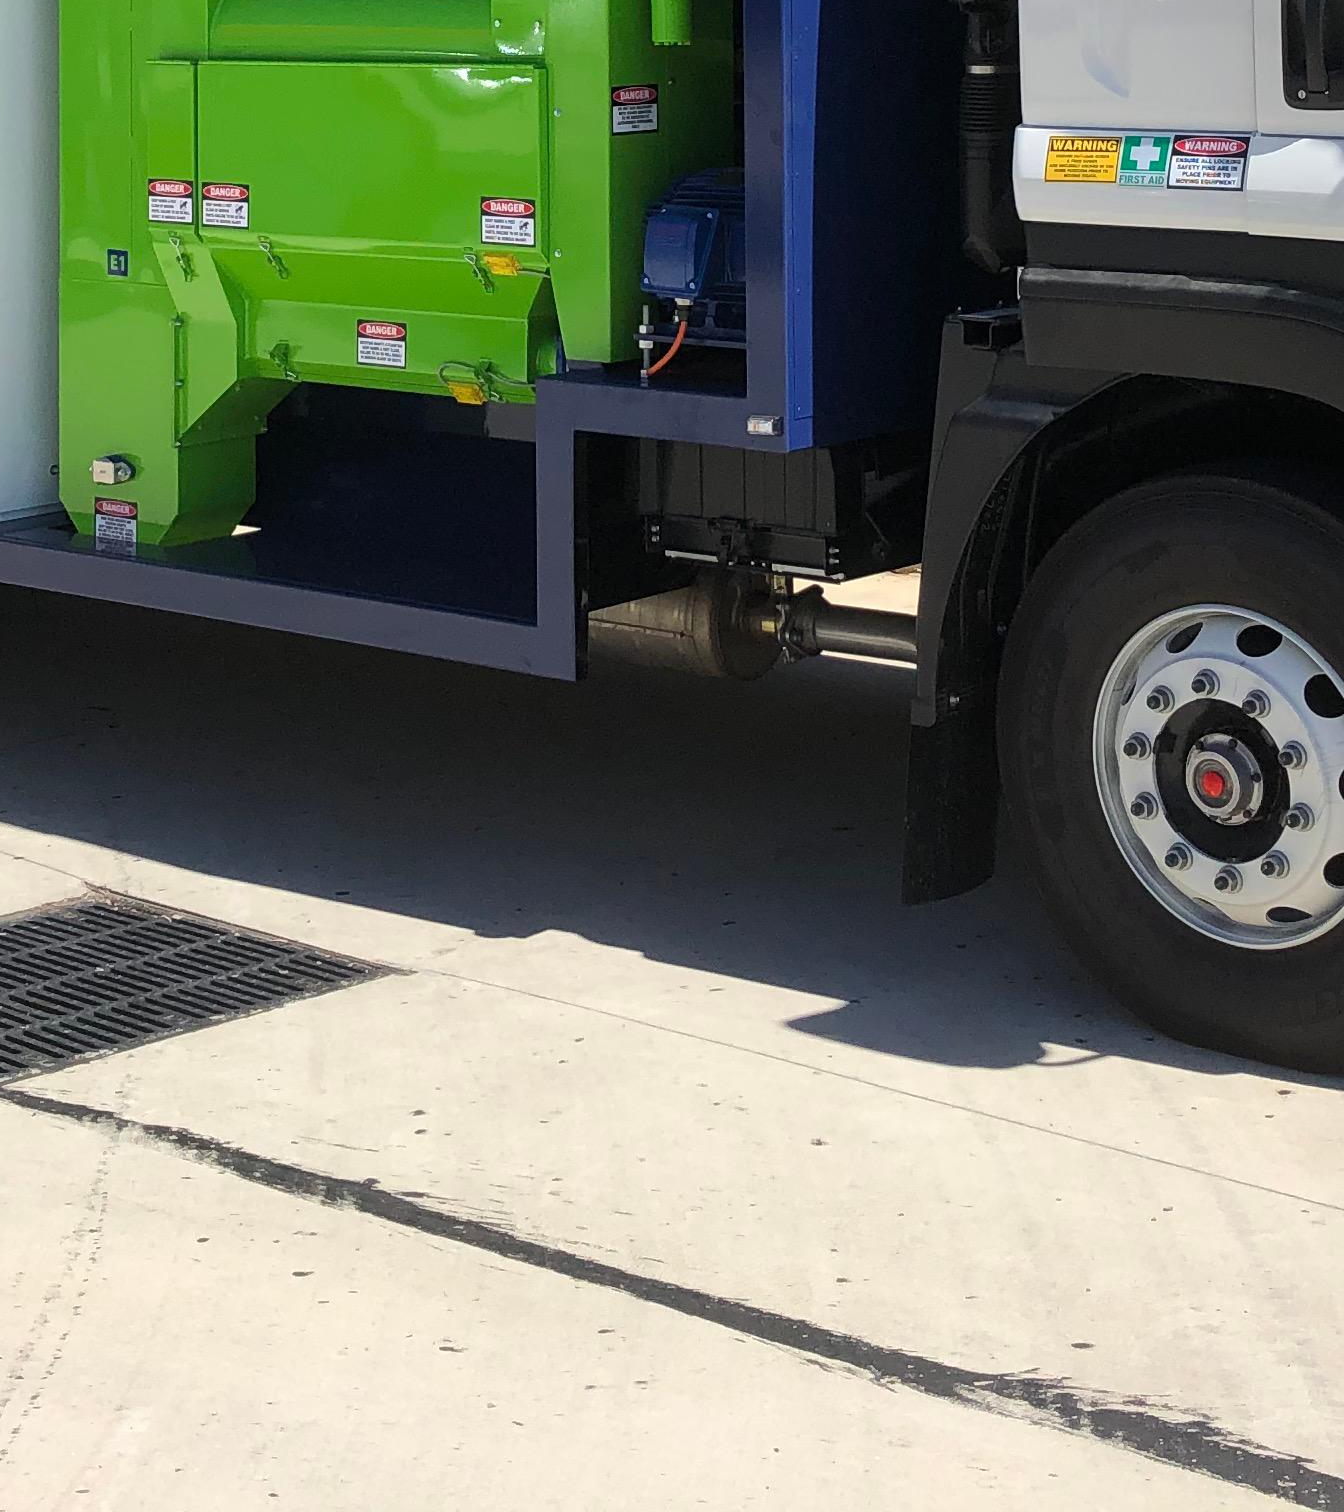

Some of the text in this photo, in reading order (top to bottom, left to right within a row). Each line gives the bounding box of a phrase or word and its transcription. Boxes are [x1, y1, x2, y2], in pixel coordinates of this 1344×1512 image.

[620, 90, 649, 100] DANGER
[1052, 139, 1118, 151] WARNING
[1185, 140, 1237, 151] WARNING
[1119, 175, 1164, 185] FIRST AID
[156, 183, 184, 193] DANGER
[210, 187, 240, 197] DANGER
[490, 202, 524, 213] DANGER
[111, 255, 124, 271] E1
[366, 325, 397, 335] DANGER
